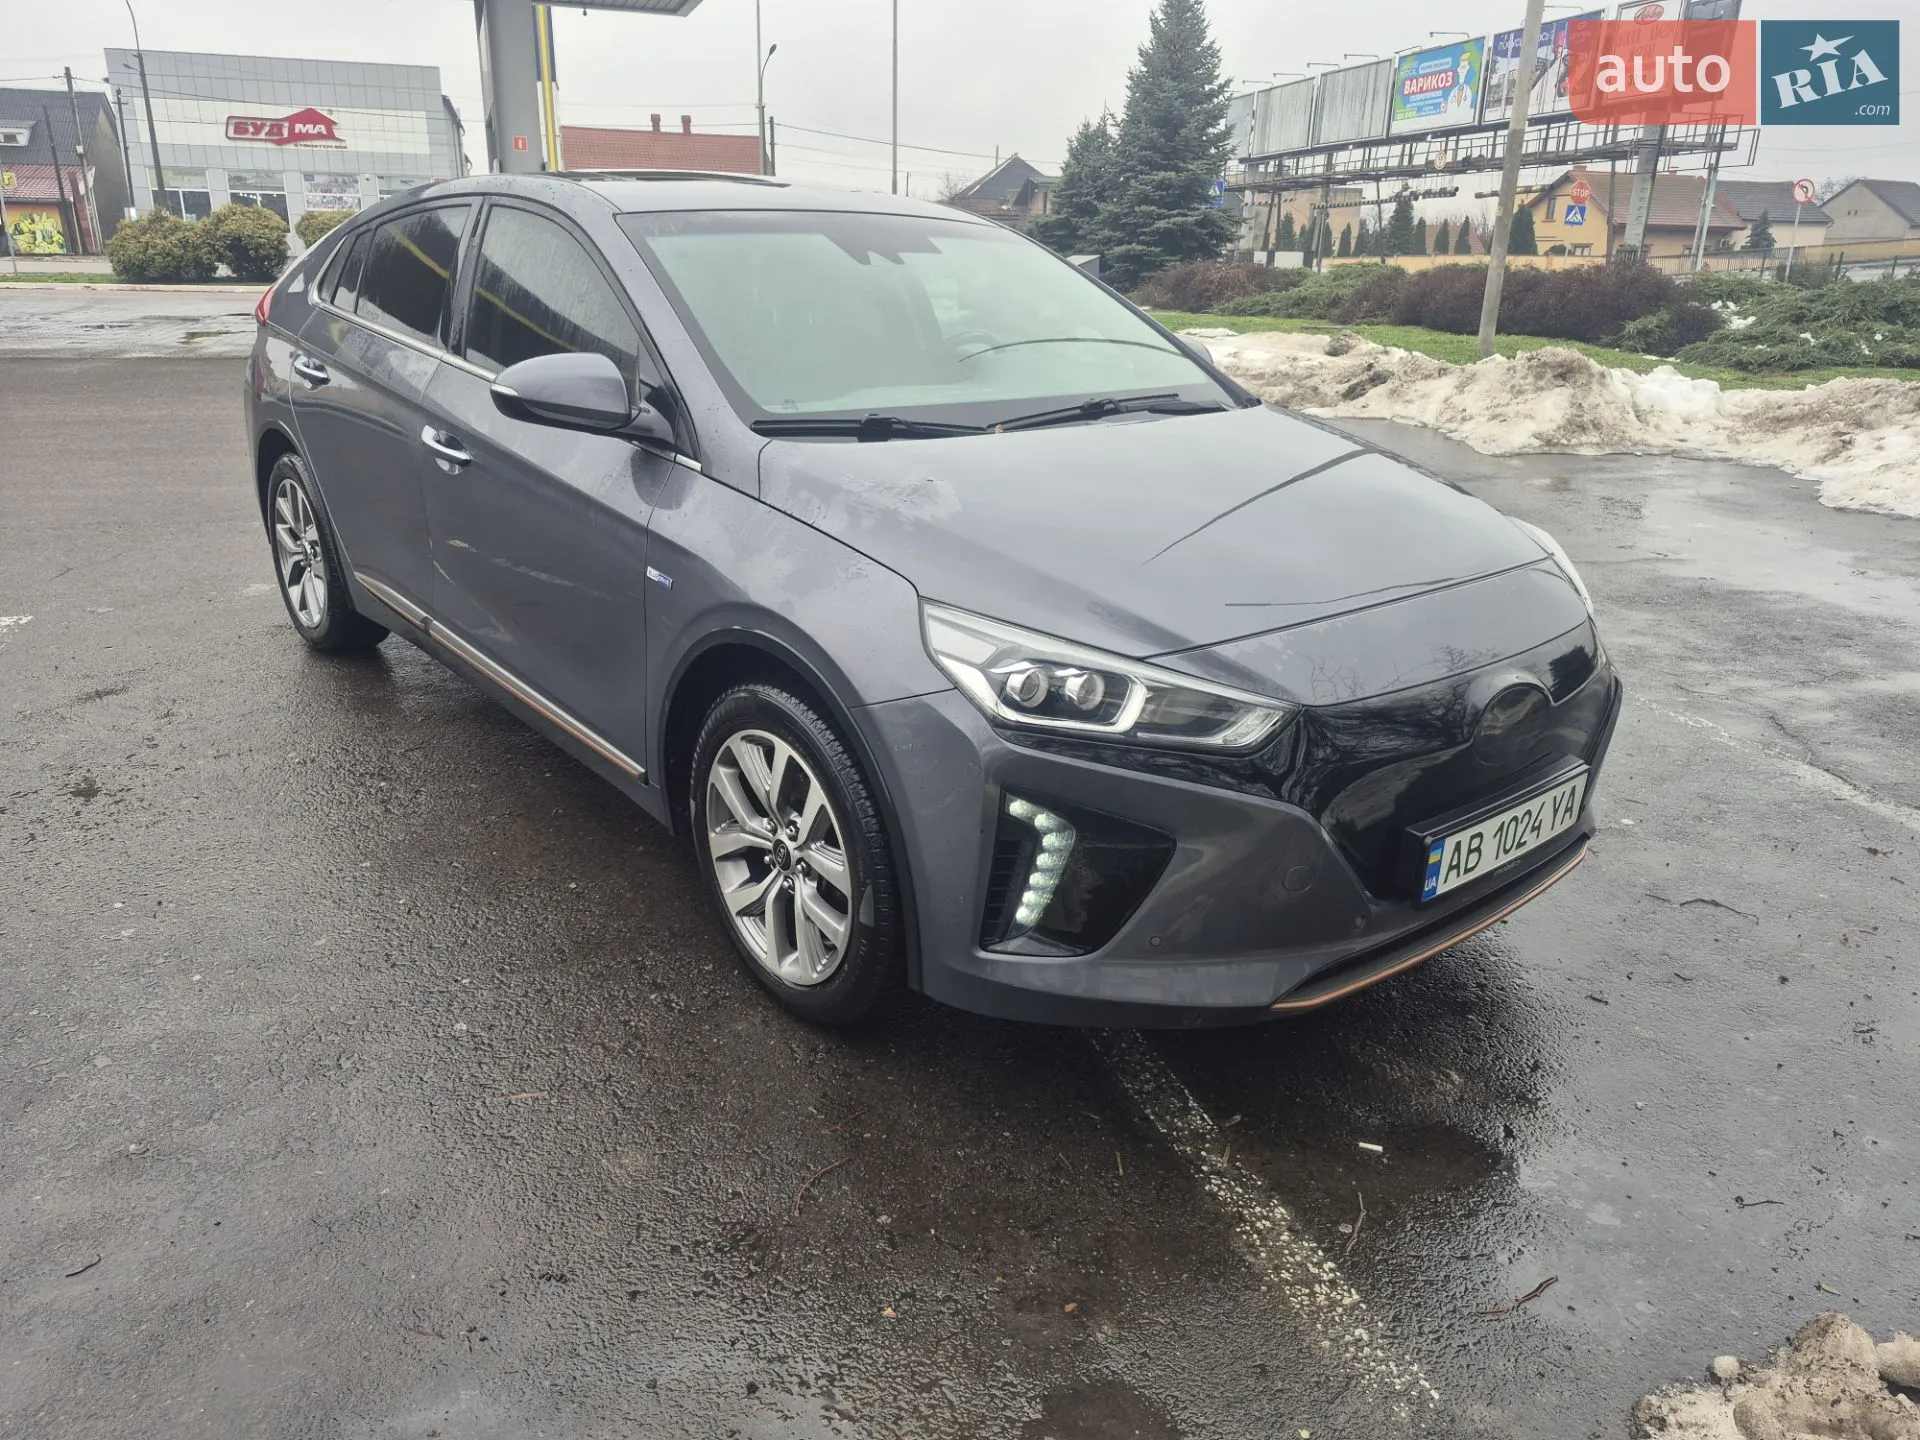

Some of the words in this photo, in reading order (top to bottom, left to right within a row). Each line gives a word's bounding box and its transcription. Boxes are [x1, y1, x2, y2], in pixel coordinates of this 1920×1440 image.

[1403, 71, 1453, 95] ВАРИКОЗ
[1573, 188, 1590, 198] STOP
[1443, 831, 1484, 885] AB
[1493, 801, 1545, 860] 1024
[1550, 784, 1577, 832] YA
[1424, 875, 1437, 891] UA
